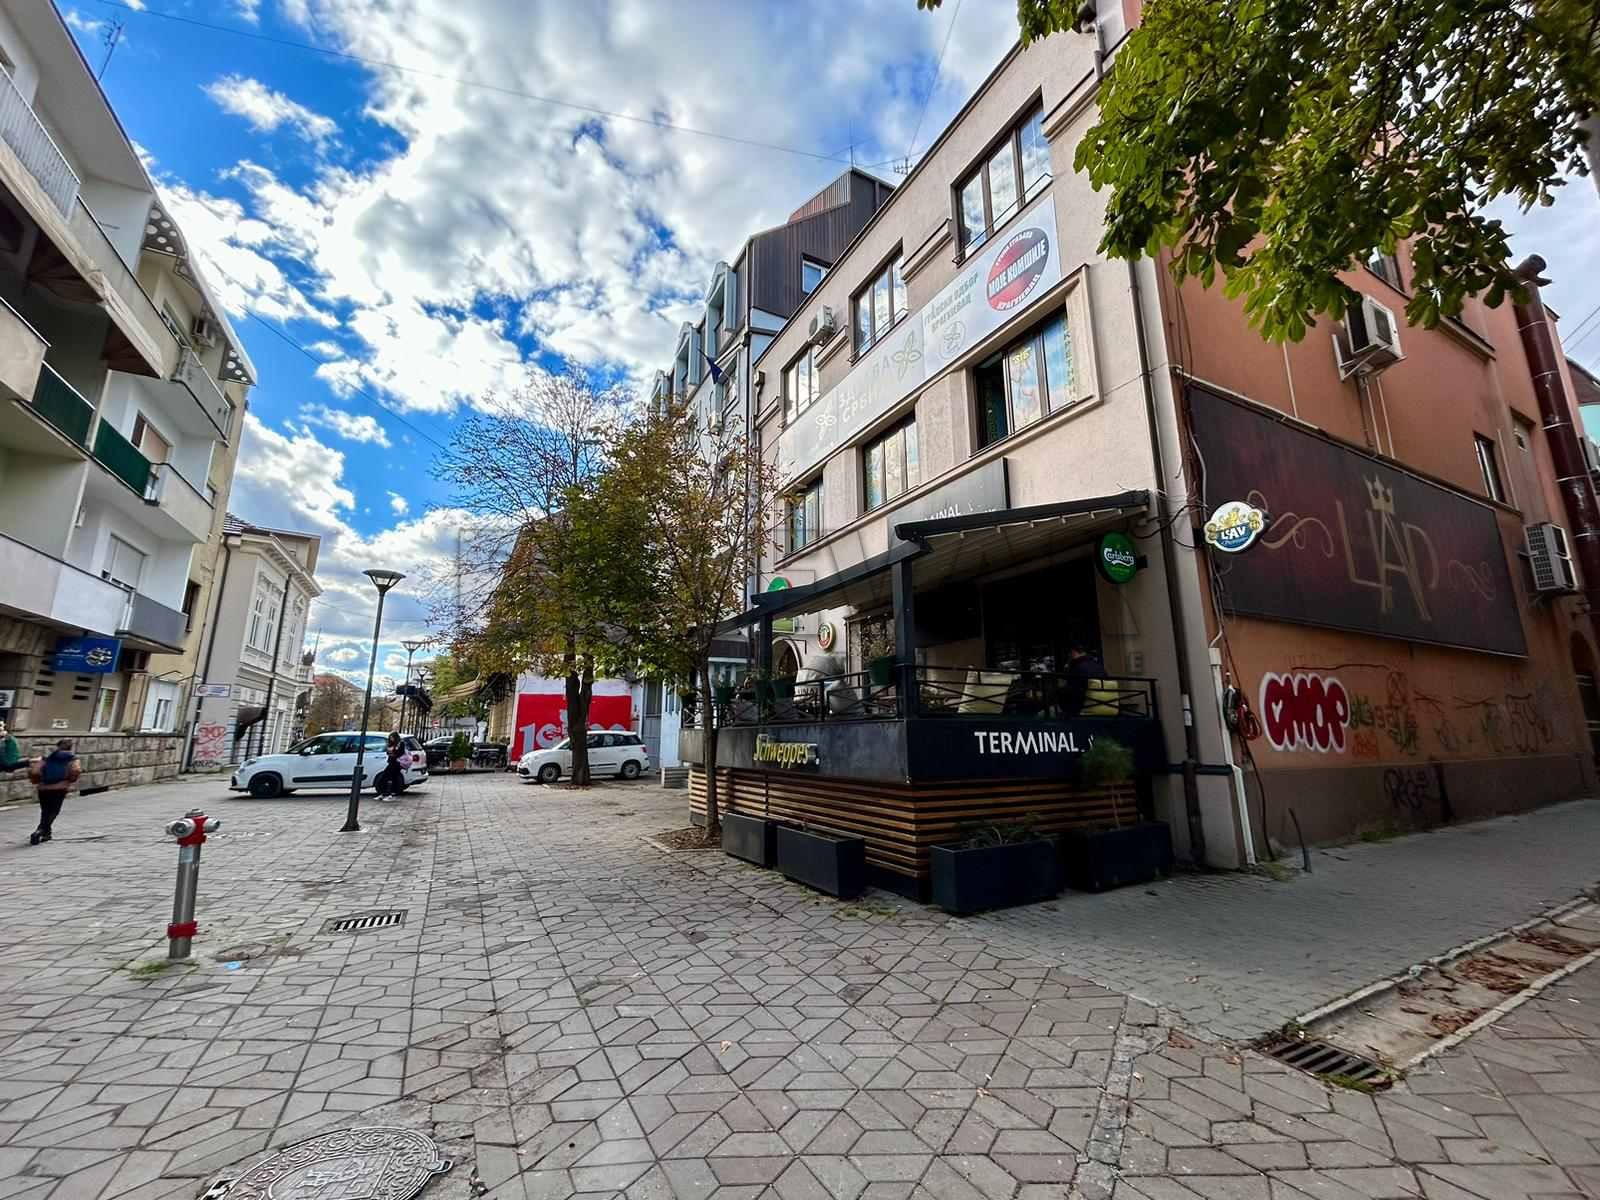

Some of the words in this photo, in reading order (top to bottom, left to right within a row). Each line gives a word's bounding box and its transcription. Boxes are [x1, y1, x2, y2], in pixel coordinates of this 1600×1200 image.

[1103, 547, 1135, 567] Carlsberg
[753, 733, 809, 769] Schweppes
[974, 731, 1080, 755] TERMINAL
